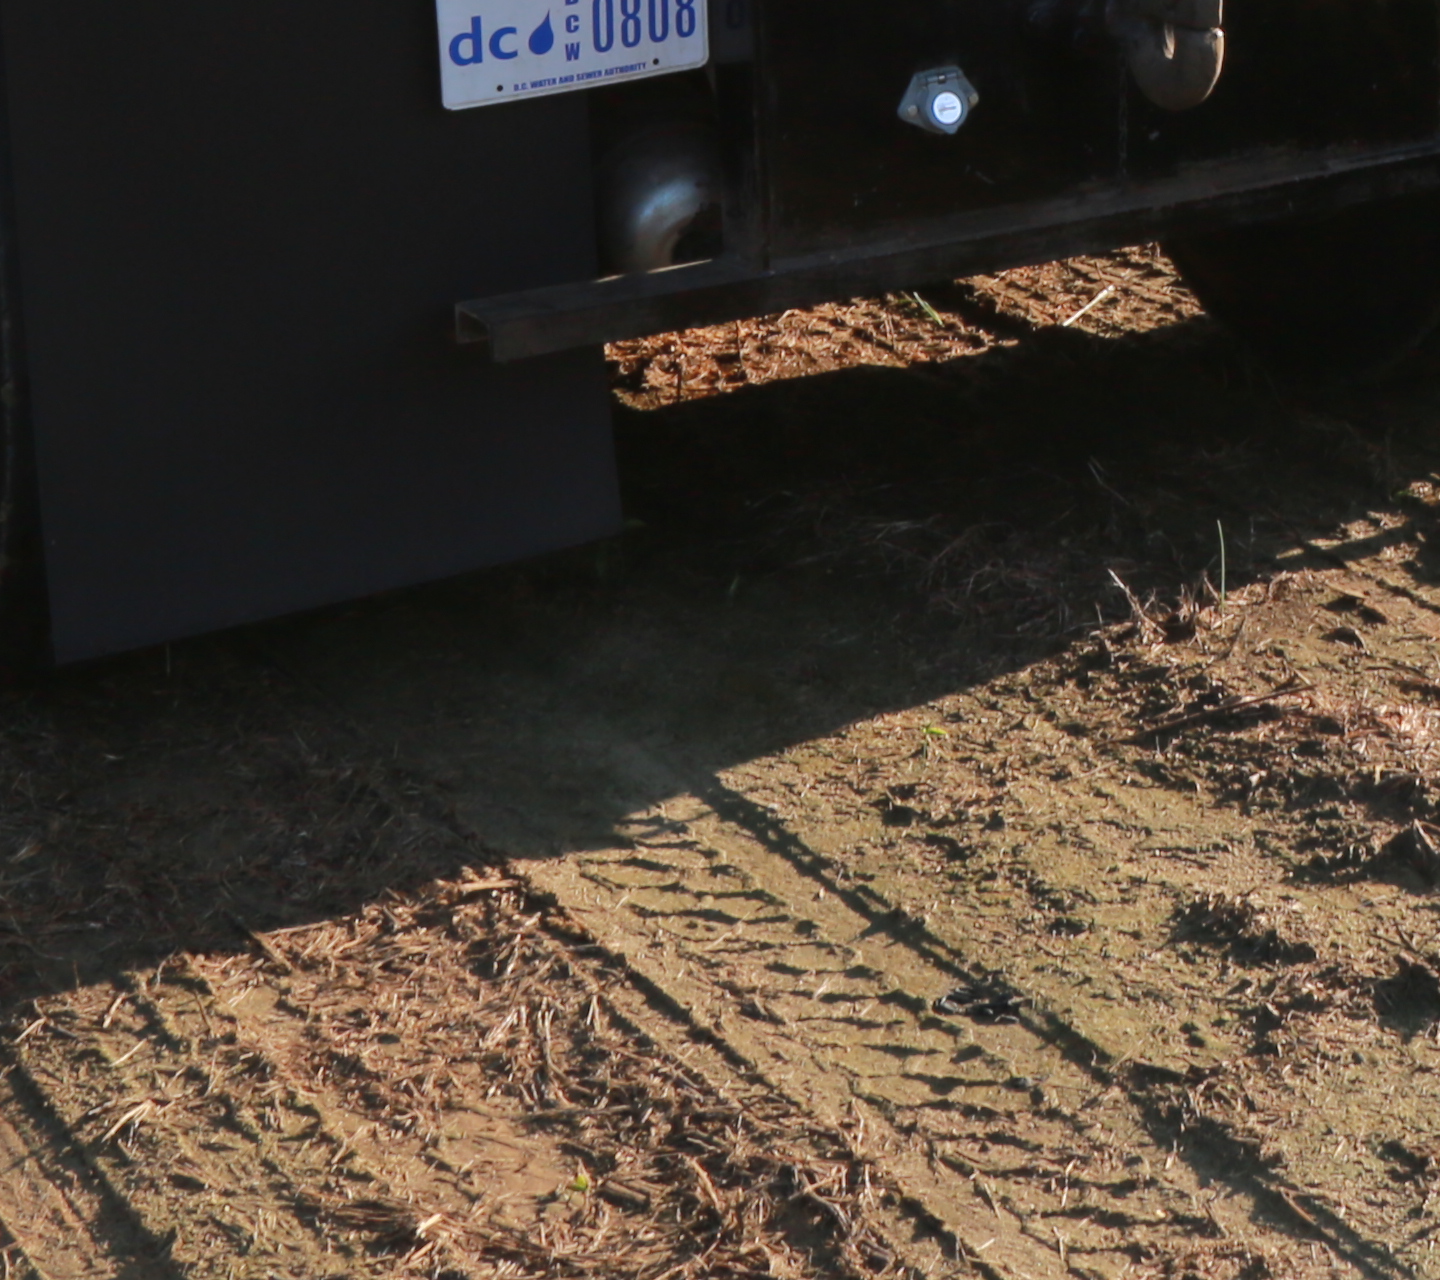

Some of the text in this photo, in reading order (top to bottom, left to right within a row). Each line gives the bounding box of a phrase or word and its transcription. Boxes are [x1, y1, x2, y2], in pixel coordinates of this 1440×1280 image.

[448, 15, 519, 67] dc
[530, 77, 557, 89] WATER
[558, 74, 575, 84] AND
[576, 69, 602, 81] SEWER
[604, 62, 647, 77] AUTHORITY
